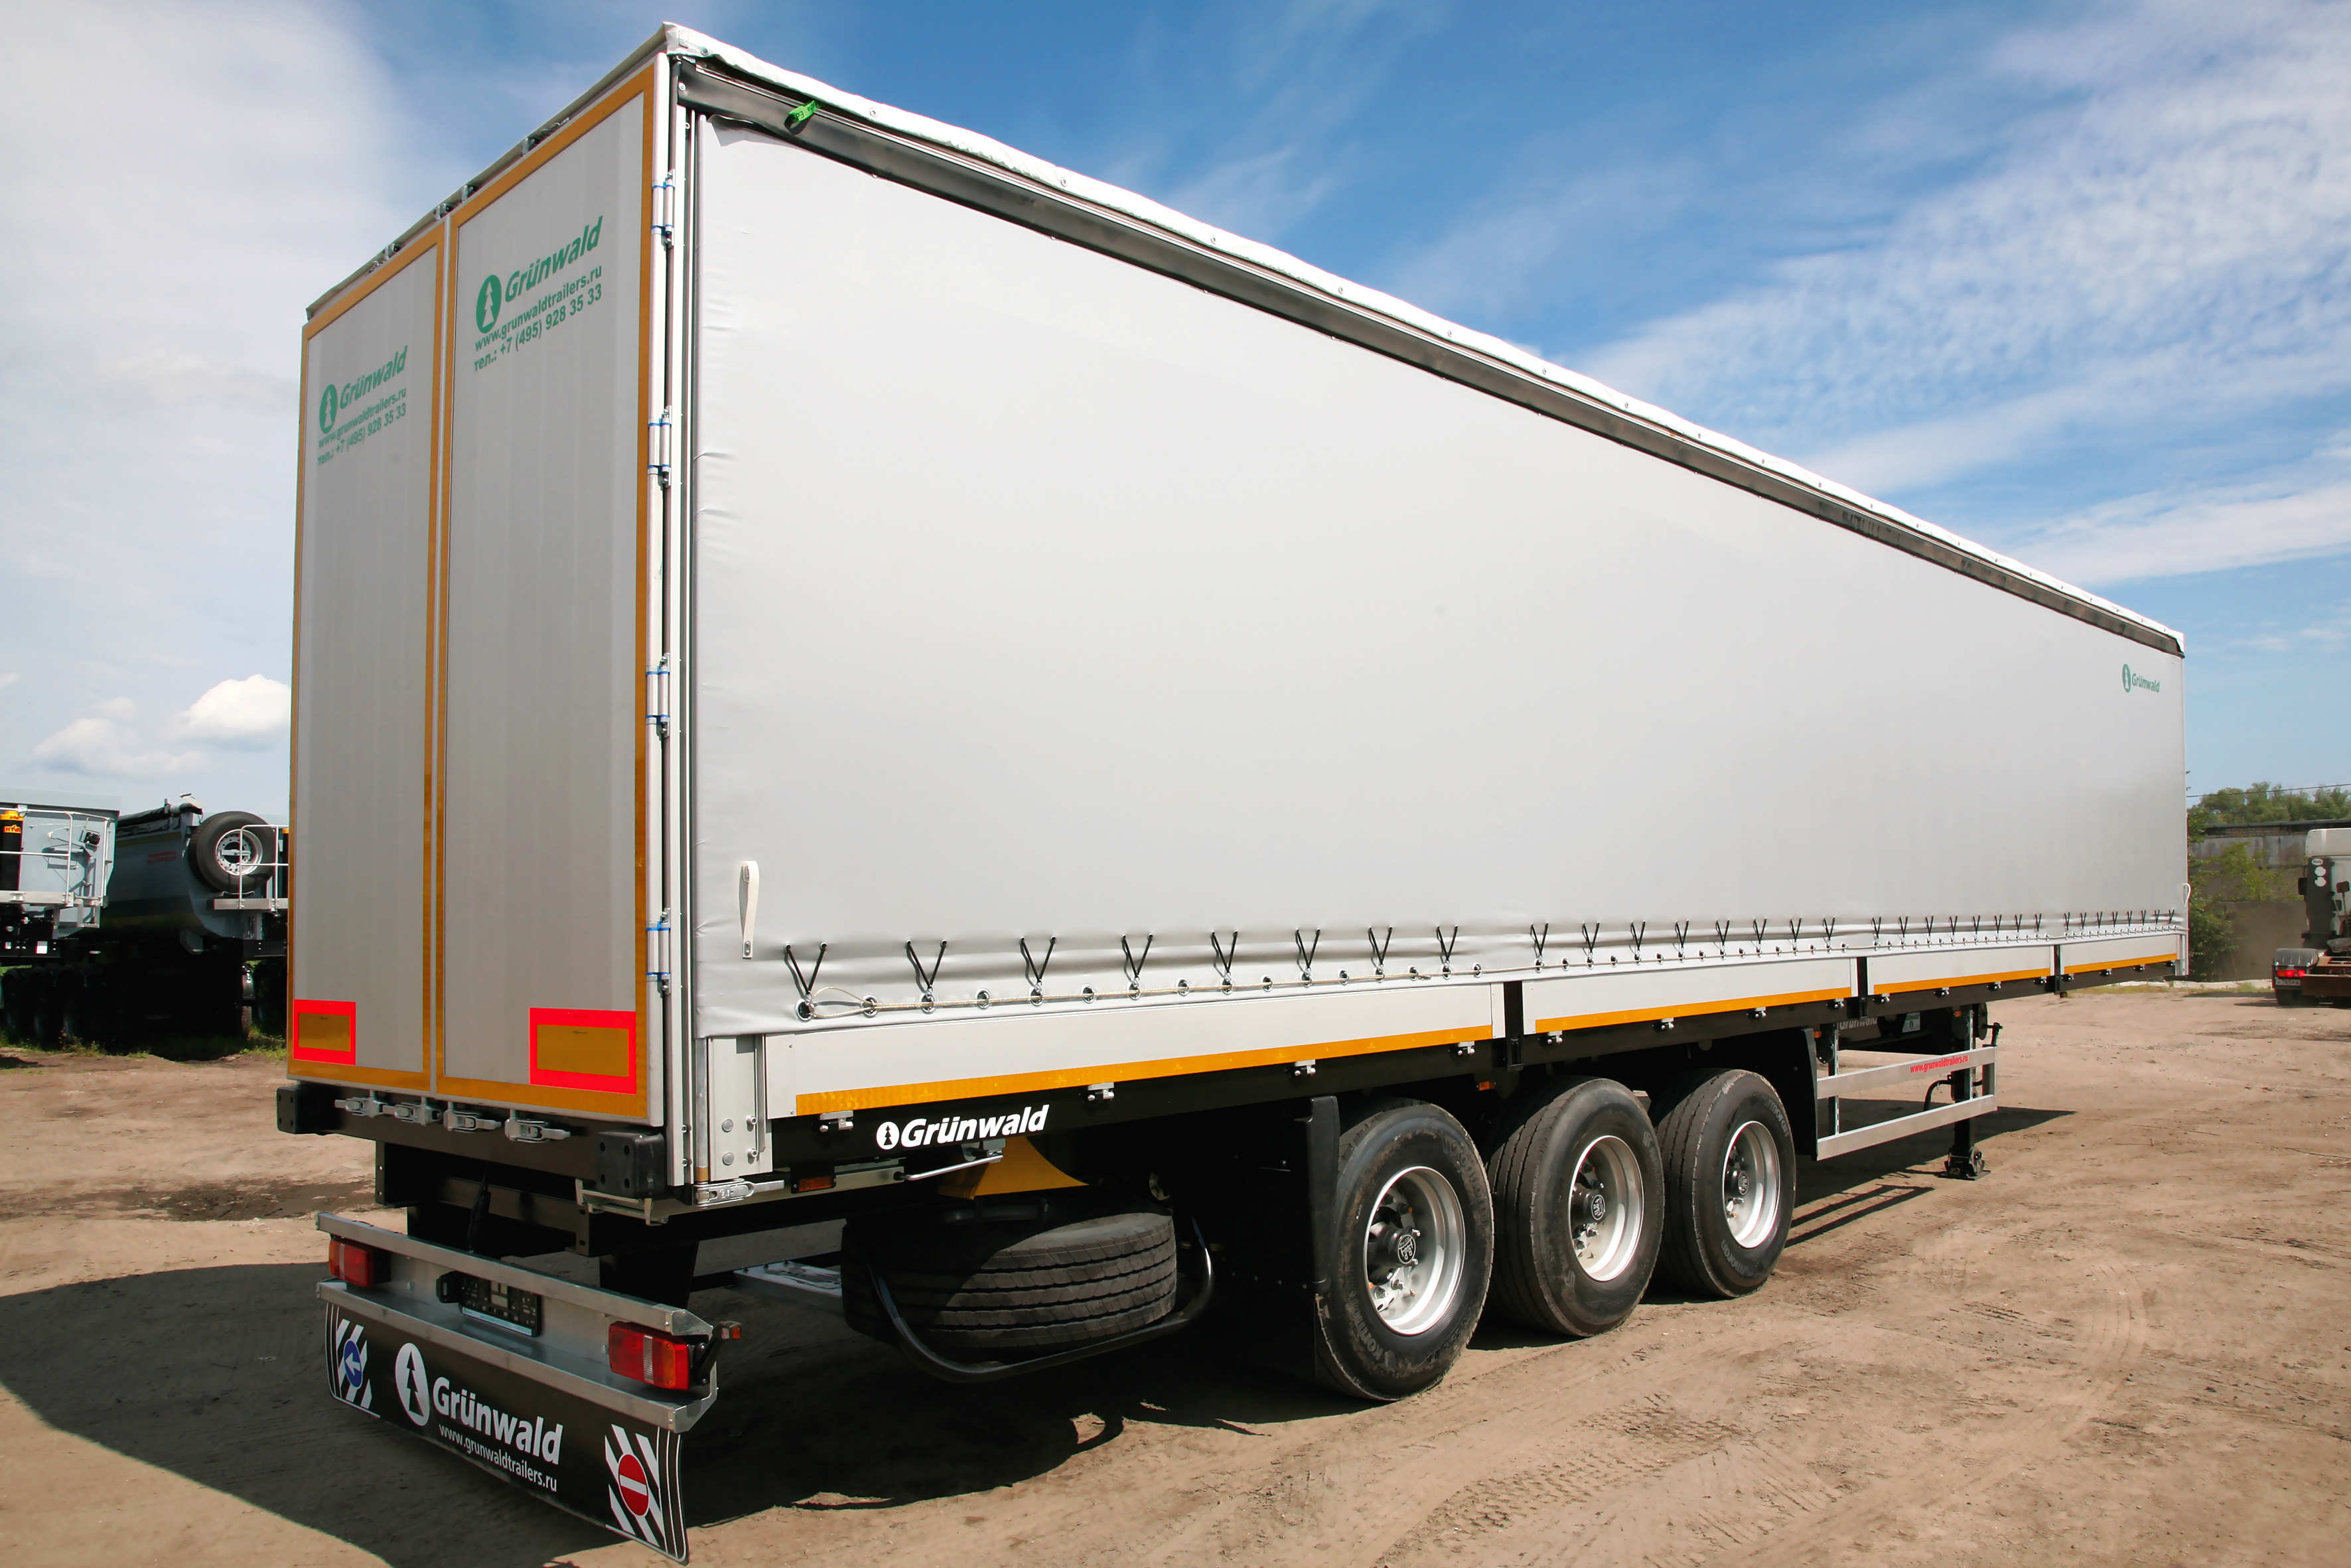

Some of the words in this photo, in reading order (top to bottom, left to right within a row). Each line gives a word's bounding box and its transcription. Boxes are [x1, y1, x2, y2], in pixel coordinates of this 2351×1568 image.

[505, 215, 603, 303] Grünwald
[475, 266, 602, 352] www.grunwaldtrailers.ru
[500, 336, 512, 355] +7
[516, 319, 543, 352] (495)
[545, 305, 566, 330] 928
[570, 294, 583, 316] 35
[587, 283, 602, 305] 33
[340, 345, 408, 409] Grünwald
[368, 417, 382, 437] 928
[384, 409, 393, 427] 35
[395, 402, 406, 420] 33
[2132, 673, 2160, 693] Grünwald
[900, 1104, 1050, 1148] Grünwald
[433, 1376, 563, 1465] Grünwald
[439, 1424, 557, 1492] www.grunwaldtrailers.ru
